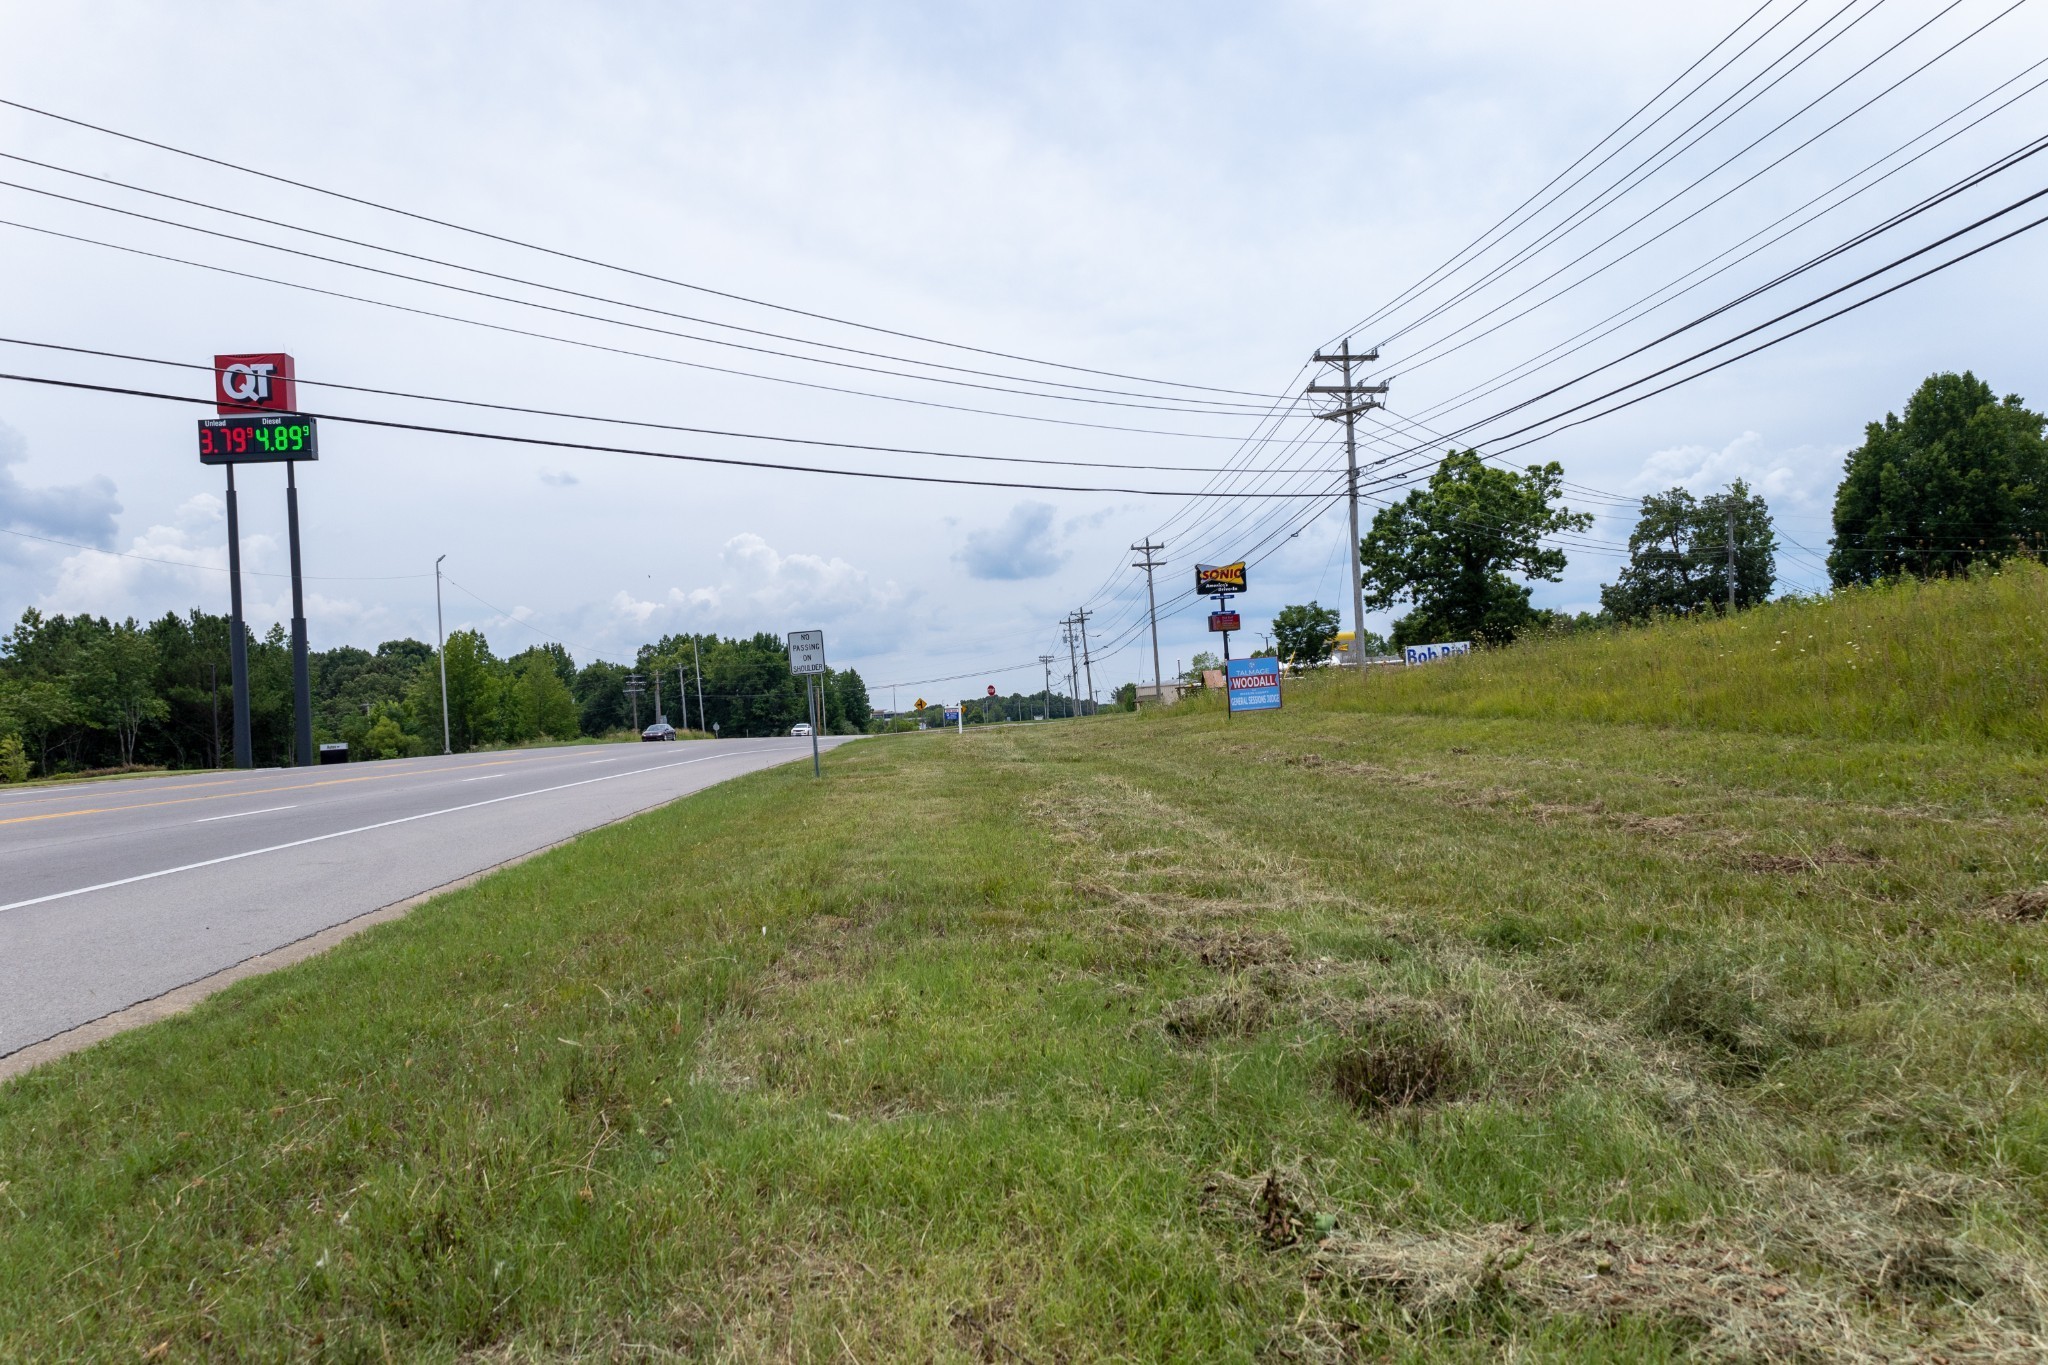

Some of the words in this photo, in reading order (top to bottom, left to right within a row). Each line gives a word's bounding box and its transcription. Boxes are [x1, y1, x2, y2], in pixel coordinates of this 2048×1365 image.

[222, 363, 274, 402] QT
[1202, 568, 1242, 581] SONIC
[792, 643, 820, 652] PASSING
[793, 664, 823, 672] SHOULDER
[1236, 667, 1270, 676] TALMAGE
[1232, 675, 1275, 689] WOODALL
[1231, 696, 1248, 706] GENERAL
[1248, 695, 1266, 704] SESSIONS
[1267, 694, 1280, 703] JUDGE
